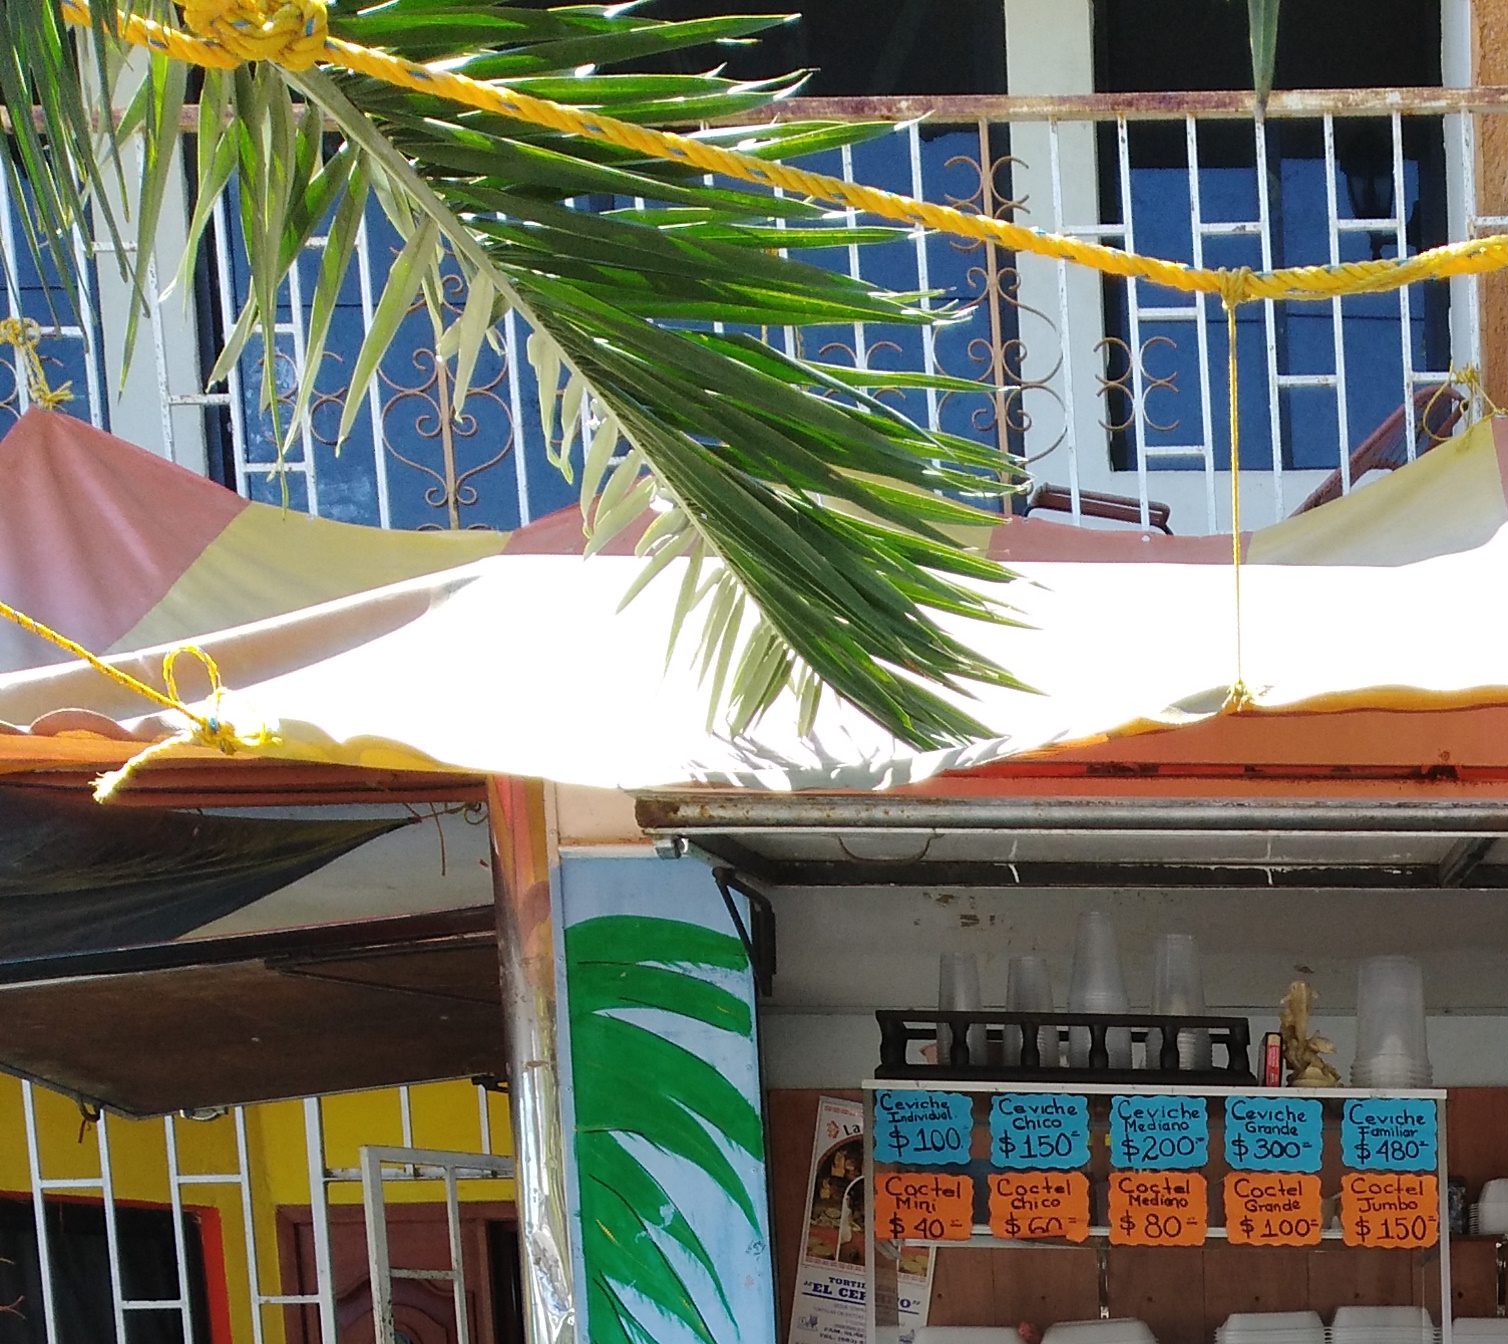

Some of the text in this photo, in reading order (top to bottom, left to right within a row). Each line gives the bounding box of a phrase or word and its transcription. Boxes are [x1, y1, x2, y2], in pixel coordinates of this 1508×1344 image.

[880, 1093, 950, 1111] Ceviche
[998, 1098, 1078, 1116] Ceviche
[1118, 1100, 1200, 1121] Ceviche
[1231, 1100, 1307, 1122] Ceviche
[1012, 1116, 1062, 1131] Chico
[1349, 1103, 1426, 1126] Ceviche
[1124, 1119, 1190, 1133] Mediano
[1245, 1121, 1298, 1136] Grande
[1358, 1126, 1418, 1139] Familiar
[885, 1176, 961, 1199] Coctel
[997, 1177, 1071, 1197] Coctel
[1118, 1177, 1190, 1194] Coctel
[1234, 1178, 1302, 1198] Coctel
[1351, 1176, 1424, 1196] Coctel
[896, 1197, 936, 1213] Mini
[1128, 1194, 1189, 1208] Mediano
[1244, 1199, 1300, 1212] Grande
[1357, 1195, 1418, 1213] Jumbo
